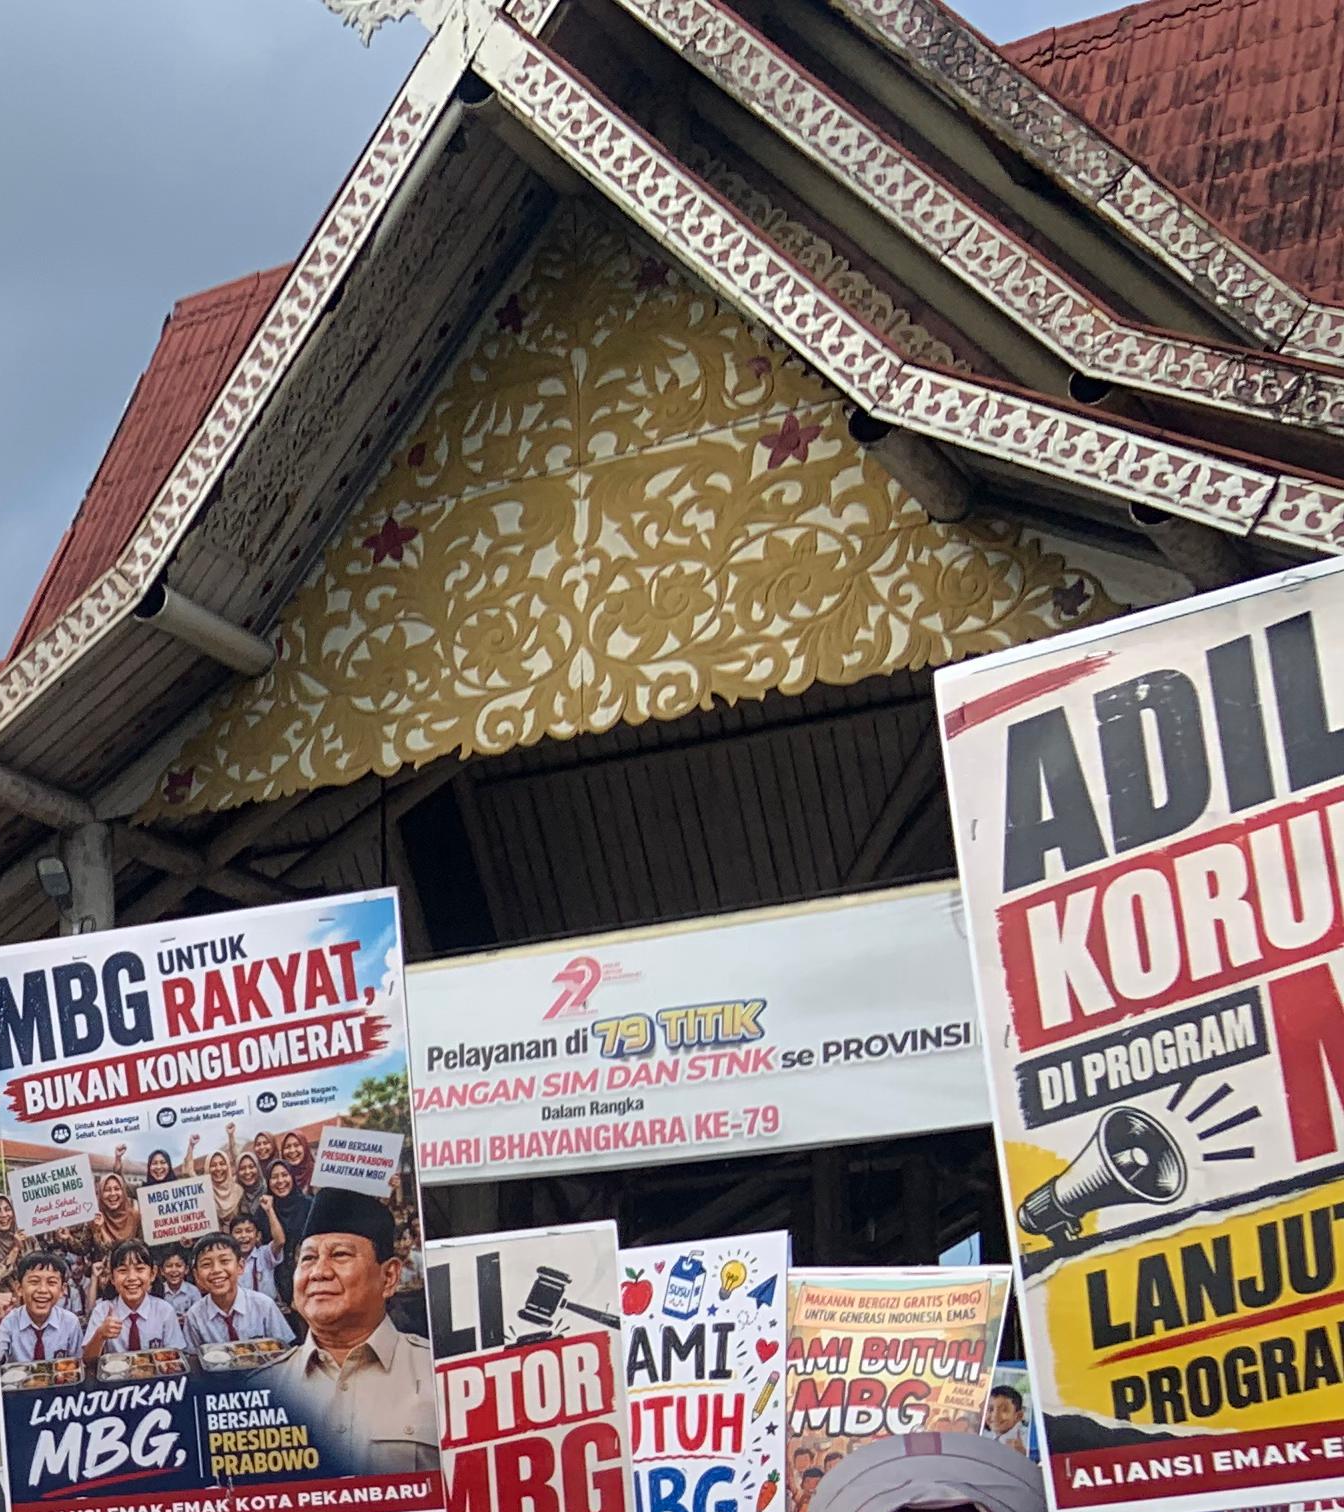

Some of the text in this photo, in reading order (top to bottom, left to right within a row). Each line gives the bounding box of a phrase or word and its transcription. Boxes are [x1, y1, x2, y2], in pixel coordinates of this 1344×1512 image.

[157, 933, 247, 975] UNTUK
[162, 940, 375, 1037] RAKYAT,
[428, 1000, 766, 1072] Pelayanan di 79 TITIK
[23, 1017, 366, 1115] BUKAN KONGLOMERAT
[542, 1068, 598, 1097] SIM
[607, 1058, 679, 1089] DAN
[687, 1046, 777, 1081] STNK
[781, 1048, 814, 1068] se
[823, 1022, 971, 1063] PROVINSI
[1038, 1010, 1257, 1111] DI PROGRAM
[542, 1097, 644, 1121] Dalam Rangka
[328, 1138, 383, 1154] KAMI BERSAMA
[421, 1105, 779, 1168] HARI BHAYANGKARA KE-79
[320, 1163, 364, 1178] LANJUTKAN
[321, 1150, 394, 1168] PRESIDEN PRABOWO
[21, 1164, 78, 1189] EMAK-EMAK
[22, 1177, 83, 1203] DUKUNG MBG
[147, 1183, 204, 1204] MBG UNTUK
[153, 1211, 206, 1229] BUKAN UNTUK
[668, 1284, 690, 1297] SUSU
[804, 1290, 982, 1309] MAKANAN BERGIZI GRATIS (MBG)
[804, 1307, 976, 1324] UNTUK GENERASI INDONESIA EMAS
[859, 1336, 986, 1382] BUTUH
[1111, 1323, 1344, 1424] PROGRA
[30, 1376, 188, 1426] LANJUTKAN
[206, 1390, 271, 1411] RAKYAT
[790, 1377, 931, 1437] MBG
[208, 1408, 288, 1431] BERSAMA
[28, 1408, 187, 1487] MBG,
[210, 1425, 308, 1454] PRESIDEN
[212, 1447, 319, 1477] PRABOWO
[1072, 1454, 1205, 1489] ALIANSI
[237, 1494, 293, 1511] KOTA
[297, 1483, 427, 1506] PEKANBARU
